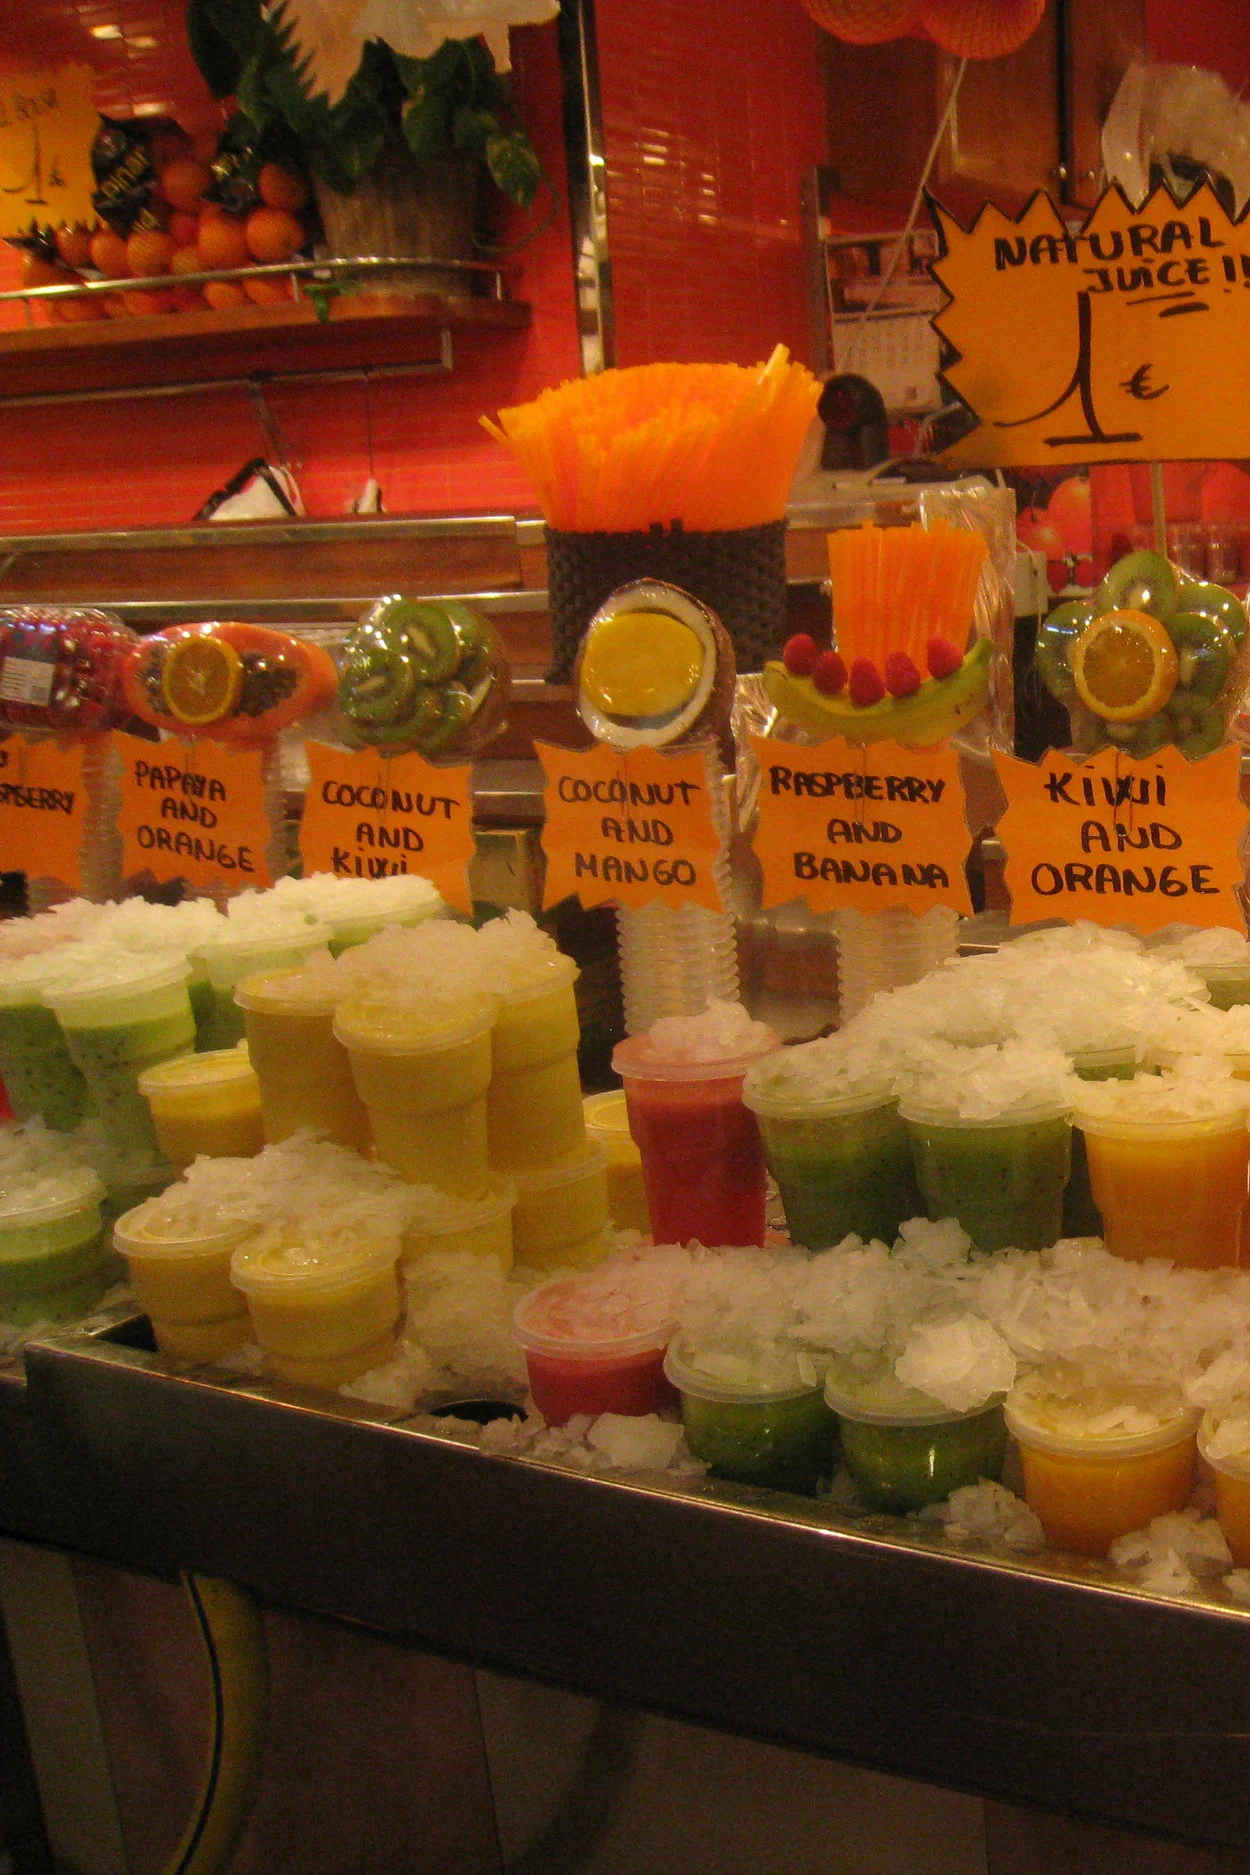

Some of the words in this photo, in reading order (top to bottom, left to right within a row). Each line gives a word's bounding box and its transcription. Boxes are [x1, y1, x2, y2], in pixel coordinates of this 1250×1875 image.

[993, 216, 1226, 271] NATURAL
[992, 290, 1143, 447] 1
[1119, 363, 1170, 400] €
[134, 760, 227, 802] PAPAYA
[559, 775, 701, 806] COCONUT
[769, 765, 946, 804] RASPBERRY
[161, 796, 218, 828] AND
[322, 780, 460, 820] COCONUT
[136, 824, 256, 873] ORANGE
[356, 822, 425, 852] AND
[601, 817, 674, 846] AND
[827, 818, 902, 844] AND
[1081, 820, 1183, 853] AND
[574, 852, 697, 886] MANGO
[793, 852, 950, 889] BANANA
[1031, 862, 1221, 897] ORANGE
